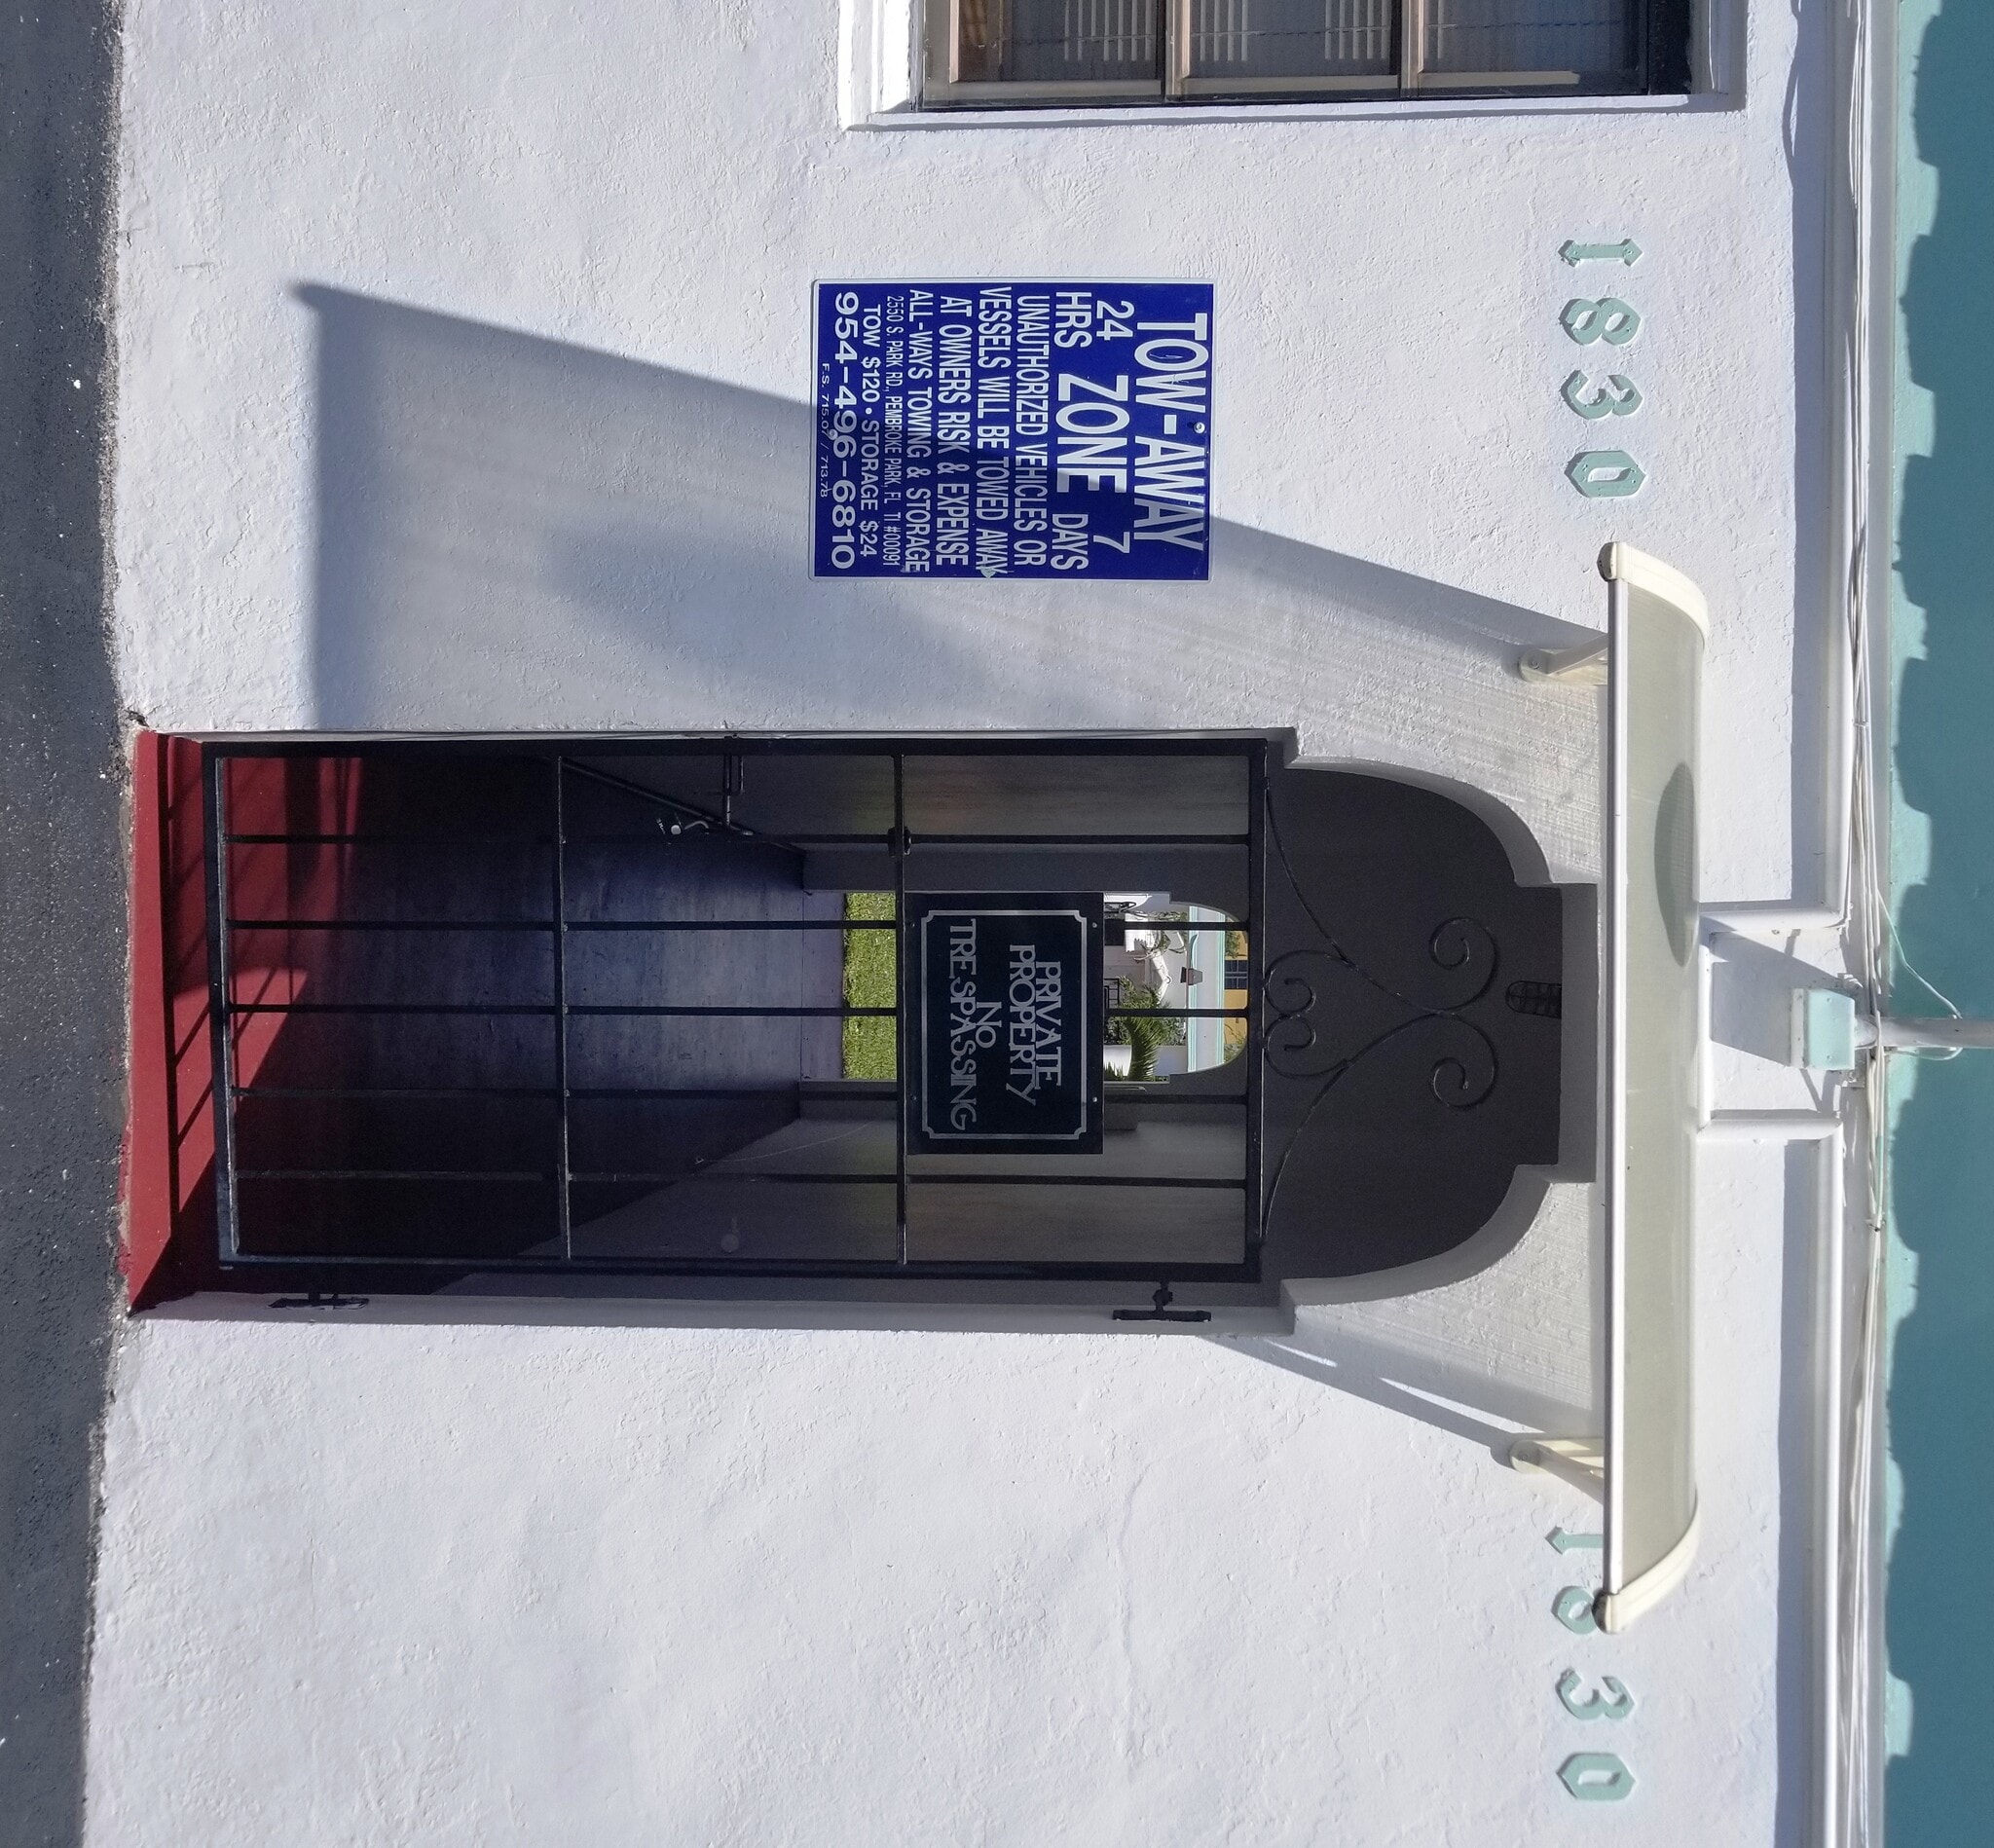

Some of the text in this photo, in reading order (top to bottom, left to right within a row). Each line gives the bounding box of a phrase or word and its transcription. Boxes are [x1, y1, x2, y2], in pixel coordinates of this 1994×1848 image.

[886, 295, 905, 322] 2550
[886, 326, 904, 337] S.
[1053, 291, 1092, 348] HRS
[1096, 300, 1135, 341] 24
[821, 362, 831, 388] F.S.
[885, 341, 904, 368] PARK
[1559, 239, 1647, 498] 1830
[820, 393, 830, 437] 715.07
[831, 291, 859, 570] 954-496-6810
[858, 304, 882, 557] TOW $120 STORAGE $24
[884, 395, 903, 454] PEMBROKE
[905, 289, 934, 573] ALL-WAYS TOWING & STORAGE
[936, 295, 973, 566] AT OWNERS RISK & EXPENSE
[975, 286, 1012, 575] VESSELS WILL BE TOWED AWAY
[1014, 295, 1051, 566] UNAUTHORIZED VEHICLES OR
[1055, 373, 1130, 494] ZONE
[1133, 313, 1209, 551] TOW-AWAY
[820, 455, 829, 499] 713.78
[881, 458, 902, 488] PARK,
[884, 492, 902, 504] FL
[883, 511, 901, 522] TI
[1050, 513, 1089, 571] DAYS
[1092, 532, 1130, 554] 7
[882, 526, 901, 566] #00091
[948, 918, 978, 1131] TRESPASSING
[1005, 943, 1036, 1106] PROPERTY
[1034, 961, 1062, 1090] PRIVATE
